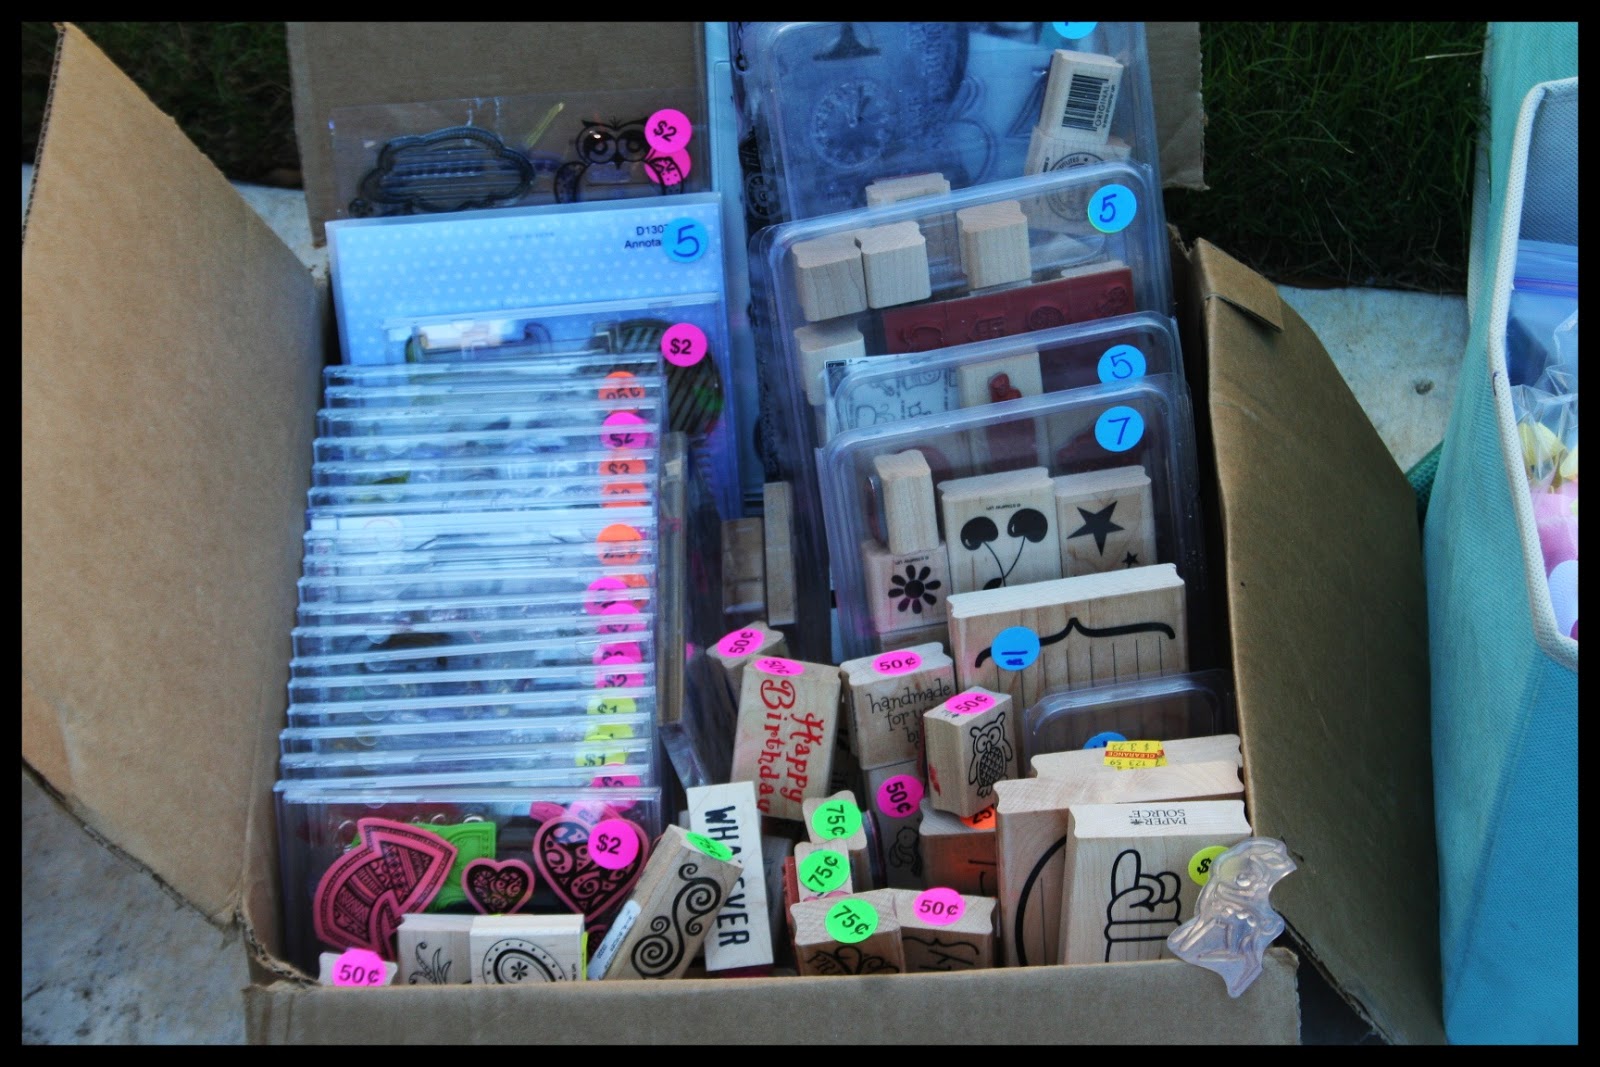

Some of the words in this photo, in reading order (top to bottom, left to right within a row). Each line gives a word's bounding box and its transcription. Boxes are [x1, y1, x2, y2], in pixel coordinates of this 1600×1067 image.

[1095, 83, 1109, 127] ORIGINAL
[653, 120, 677, 142] $2
[1099, 192, 1117, 223] 5
[636, 223, 669, 236] D130
[673, 224, 700, 258] 5
[669, 337, 692, 356] $2
[1110, 351, 1134, 379] 5
[1107, 416, 1131, 446] 7
[728, 631, 754, 654] 50¢
[880, 656, 916, 671] 50¢
[865, 677, 952, 714] handmade
[954, 695, 988, 712] 50¢
[885, 710, 910, 732] for
[779, 711, 824, 803] Happy
[1108, 751, 1156, 760] CLEARANCE
[886, 781, 913, 814] 50¢
[826, 804, 846, 836] 75¢
[1132, 808, 1186, 818] SOURCE
[1145, 817, 1187, 826] PAPER
[596, 833, 622, 855] $2
[808, 855, 841, 888] 75¢
[833, 905, 871, 935] 75¢
[919, 899, 959, 919] 50¢
[338, 963, 381, 986] 50¢
